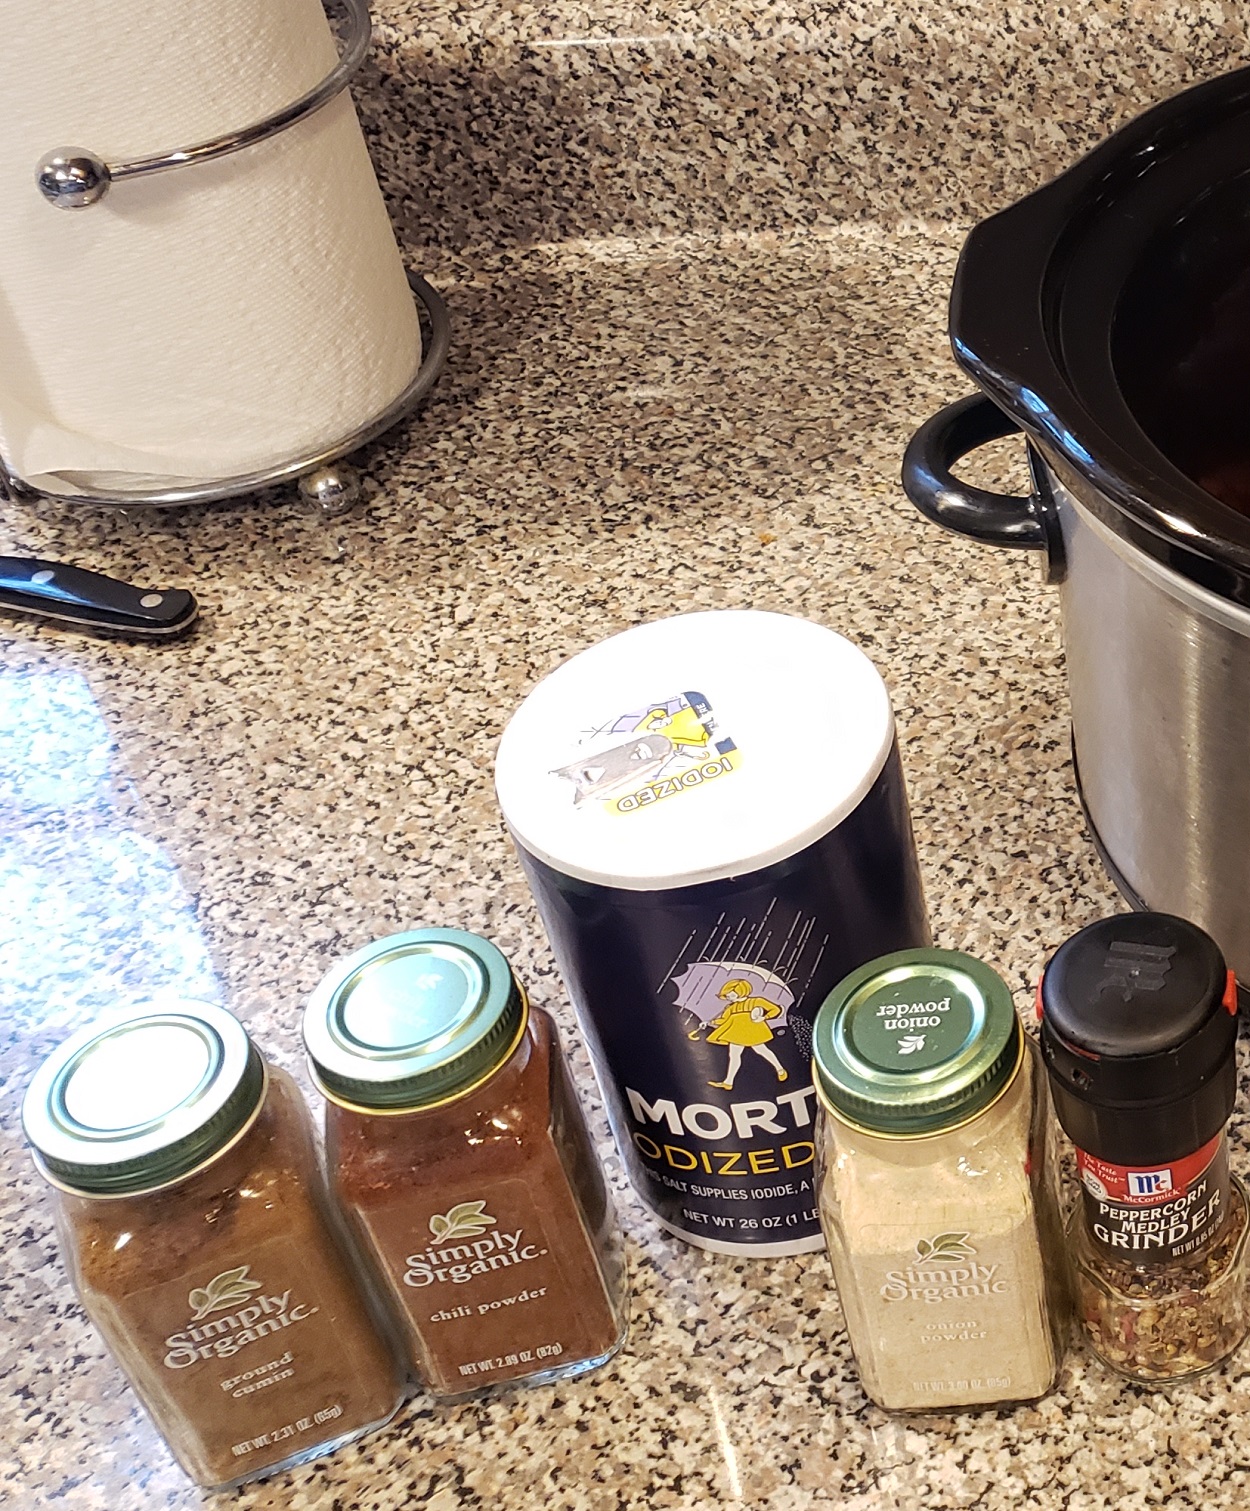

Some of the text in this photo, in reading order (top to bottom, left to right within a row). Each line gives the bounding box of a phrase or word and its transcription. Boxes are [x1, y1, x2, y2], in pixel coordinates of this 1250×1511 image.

[617, 757, 733, 812] IODIZED
[876, 997, 951, 1018] powder
[884, 1016, 941, 1032] onion
[625, 1085, 816, 1140] MORT
[633, 1132, 815, 1176] ODIZED
[662, 1175, 688, 1192] SALT
[691, 1183, 749, 1200] SUPPLIES
[750, 1183, 798, 1200] IODIDE,
[800, 1180, 810, 1192] A
[1099, 1179, 1207, 1222] PEPPERCORN
[1122, 1188, 1180, 1204] McCormick
[683, 1208, 709, 1224] NET
[711, 1216, 735, 1228] WT
[739, 1219, 758, 1229] 26
[762, 1216, 783, 1228] OZ
[785, 1213, 798, 1227] (1
[1094, 1189, 1221, 1249] GRINDER
[1121, 1207, 1190, 1234] MEDLEY
[405, 1229, 523, 1271] Simply
[886, 1262, 999, 1288] Simply
[430, 1287, 548, 1322] chili powder
[880, 1281, 1008, 1304] Organic
[165, 1288, 292, 1349] Simply
[926, 1320, 978, 1331] onion
[921, 1330, 988, 1344] powder
[220, 1351, 295, 1392] ground
[458, 1363, 478, 1376] NET
[232, 1368, 295, 1398] cumin
[231, 1441, 251, 1457] NET
